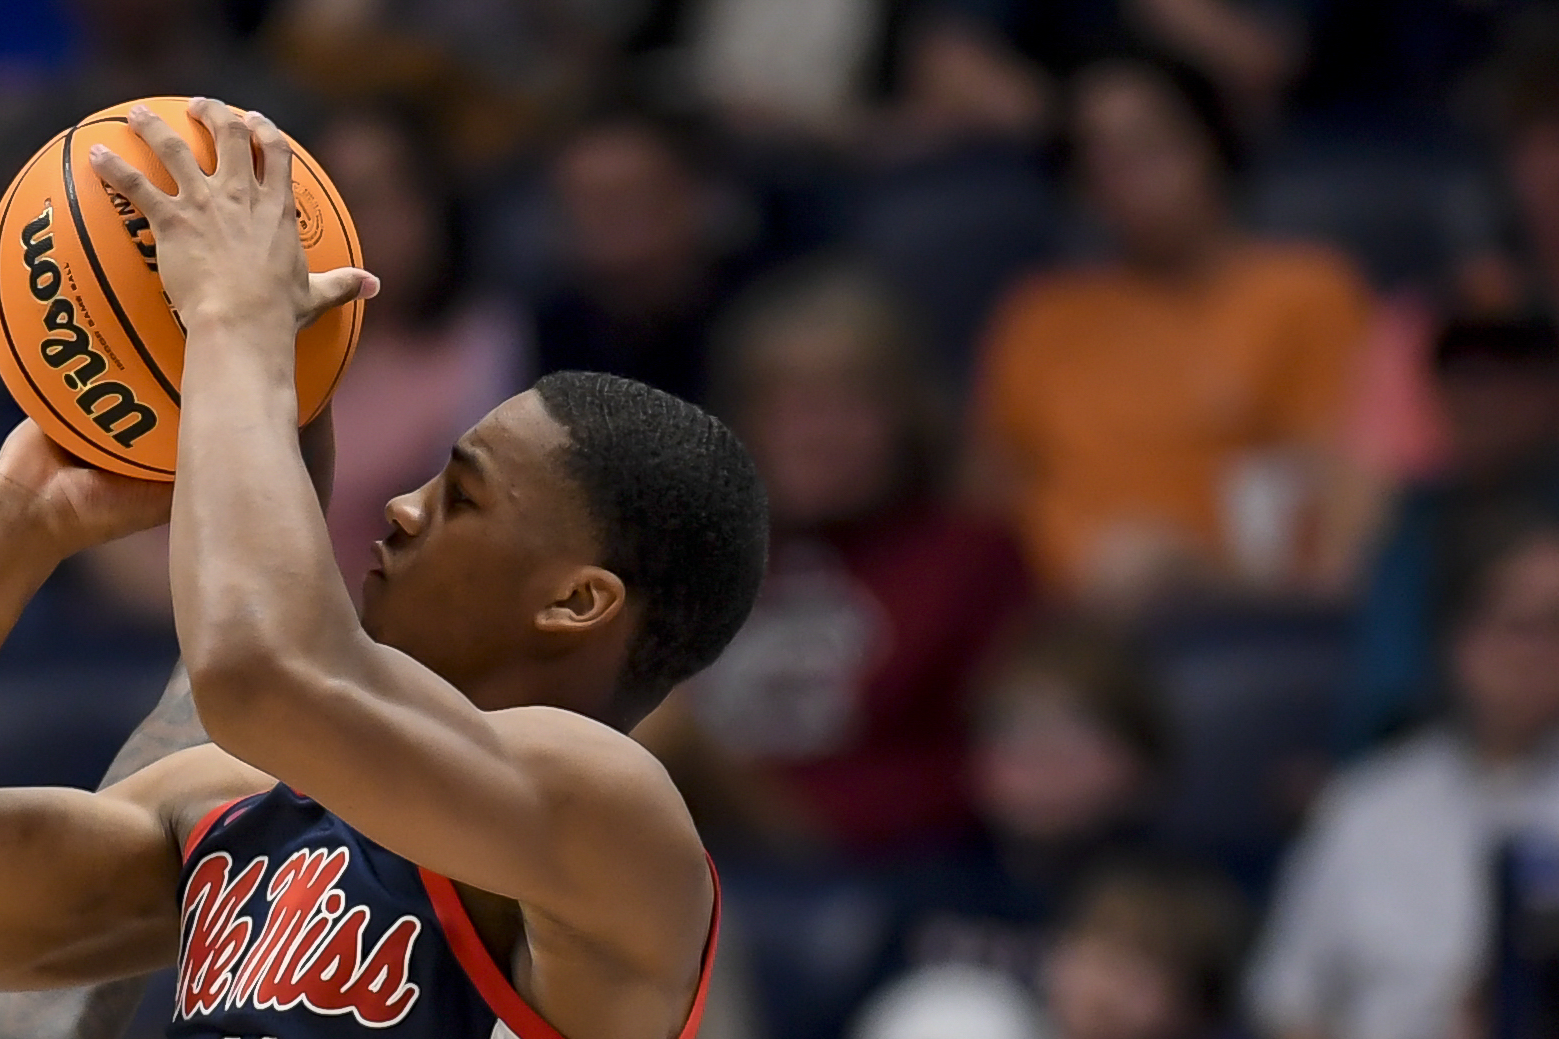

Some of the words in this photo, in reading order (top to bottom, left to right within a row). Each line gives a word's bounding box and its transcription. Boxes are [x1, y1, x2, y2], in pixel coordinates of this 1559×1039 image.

[20, 198, 158, 448] Wilson
[173, 850, 268, 1022] Ole
[225, 847, 422, 1029] Miss
